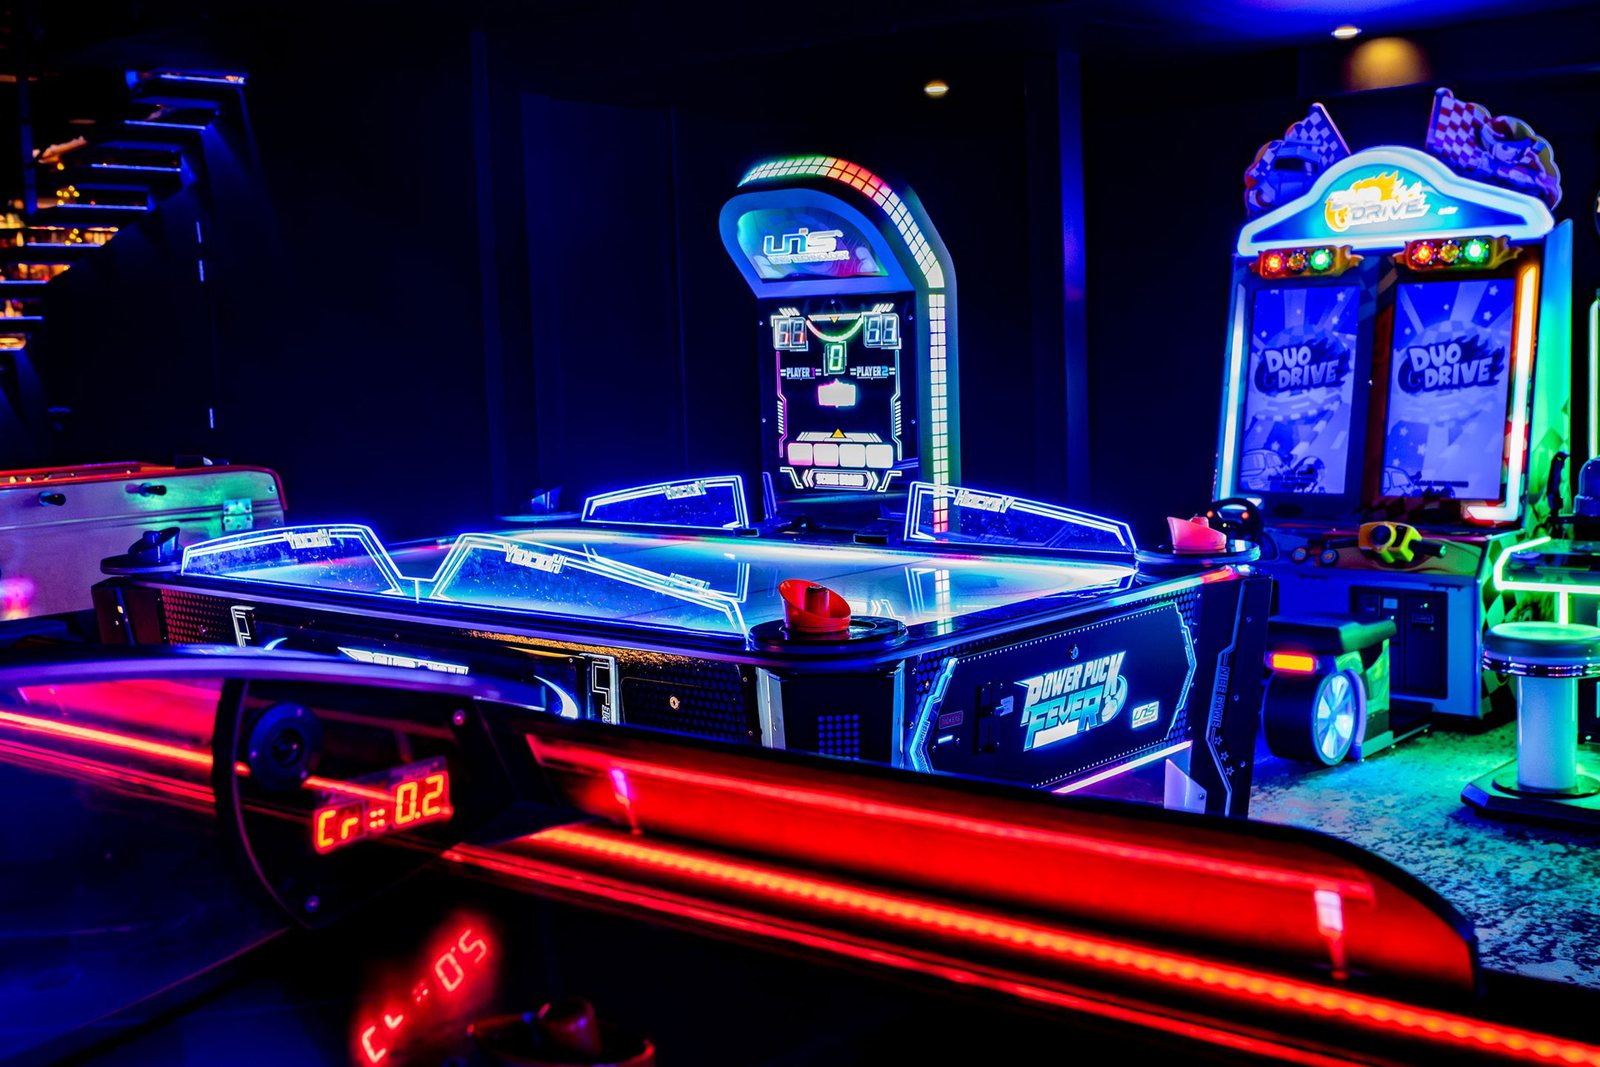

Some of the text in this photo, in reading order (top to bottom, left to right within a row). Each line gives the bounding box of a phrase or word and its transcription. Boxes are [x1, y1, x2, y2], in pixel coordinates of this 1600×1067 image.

[856, 366, 881, 378] PLAYER
[1264, 345, 1312, 373] DUO
[1409, 343, 1462, 372] DUO
[786, 367, 810, 379] PLAYER
[1278, 359, 1339, 389] DRIVE
[1424, 357, 1493, 389] DRIVE
[1014, 664, 1083, 724] POWER
[1082, 651, 1126, 699] PUCK
[1022, 685, 1104, 751] FEVER
[1211, 693, 1226, 728] GAME
